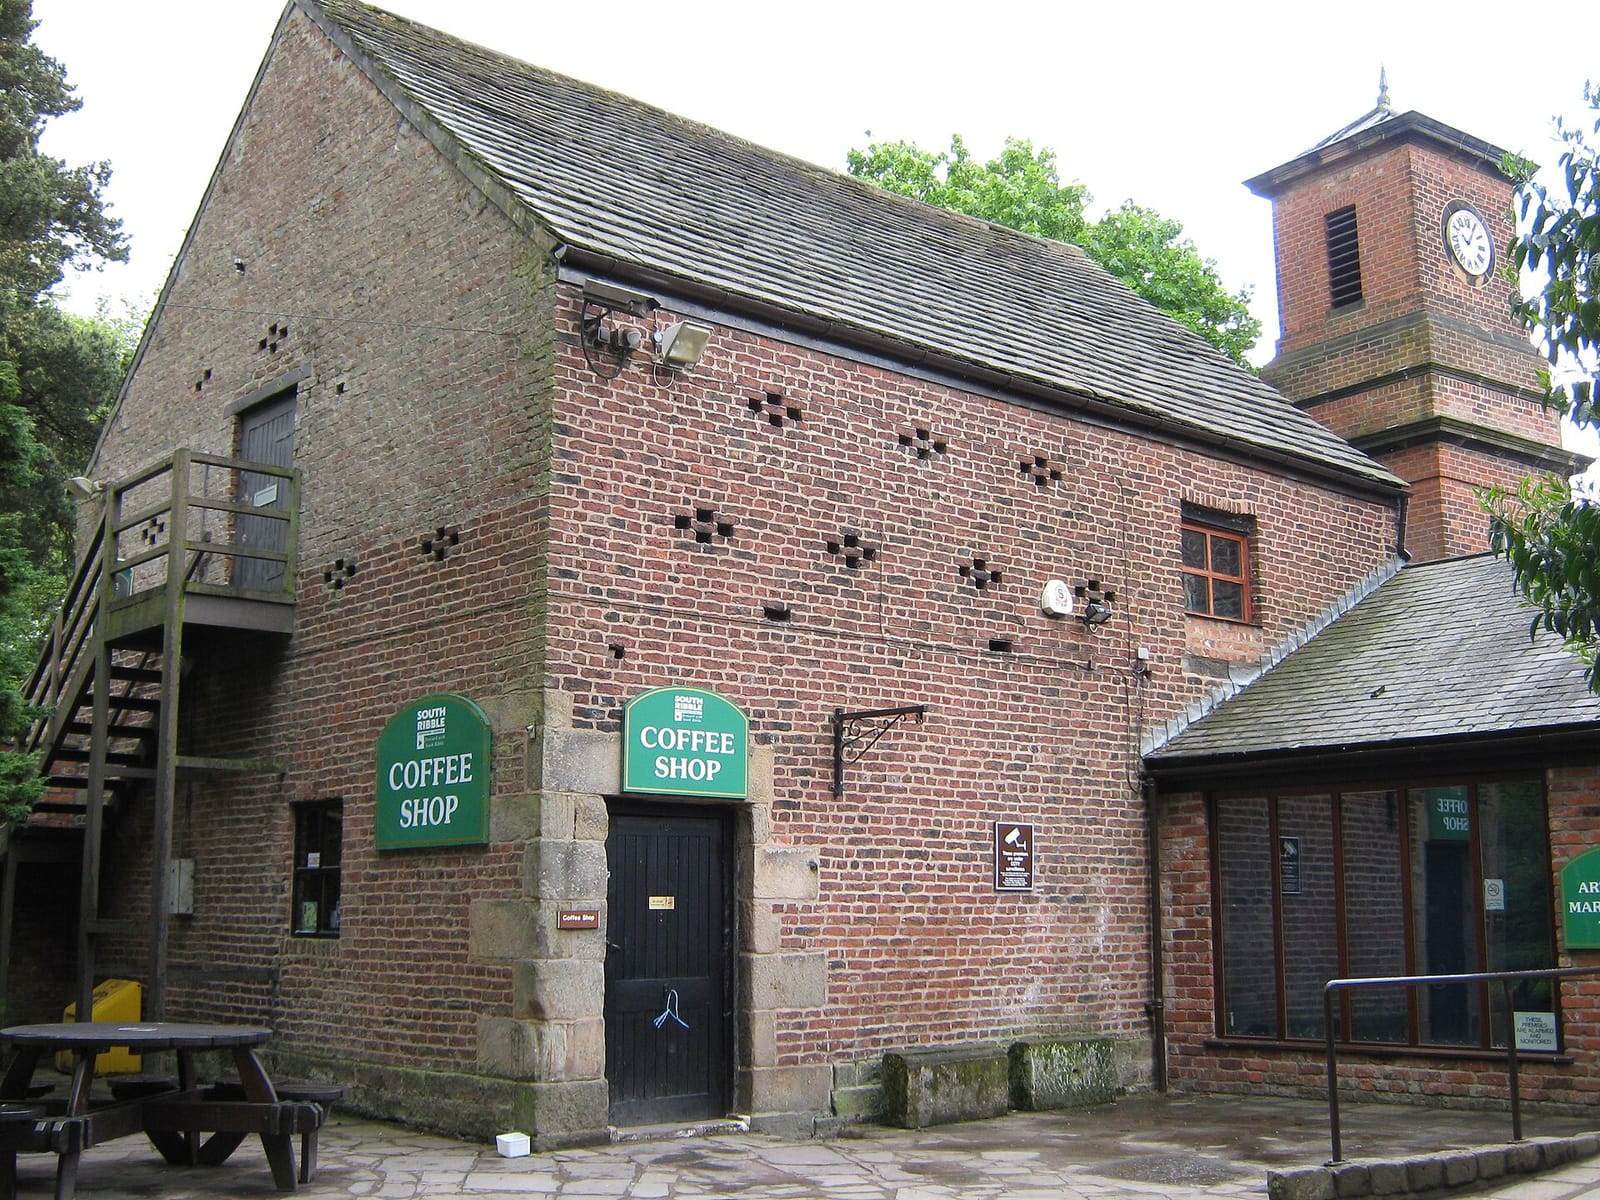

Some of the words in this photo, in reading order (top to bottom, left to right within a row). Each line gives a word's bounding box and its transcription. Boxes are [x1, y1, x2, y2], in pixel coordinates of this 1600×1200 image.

[674, 695, 704, 705] SOUTH
[674, 702, 703, 711] RIBBLE
[417, 707, 446, 720] SOUTH
[417, 717, 445, 731] RIBBLE
[640, 726, 735, 754] COFFEE
[389, 753, 473, 791] COFFEE
[654, 756, 721, 781] SHOP
[400, 795, 459, 828] SHOP
[1578, 881, 1600, 893] AR
[582, 914, 595, 922] Shop
